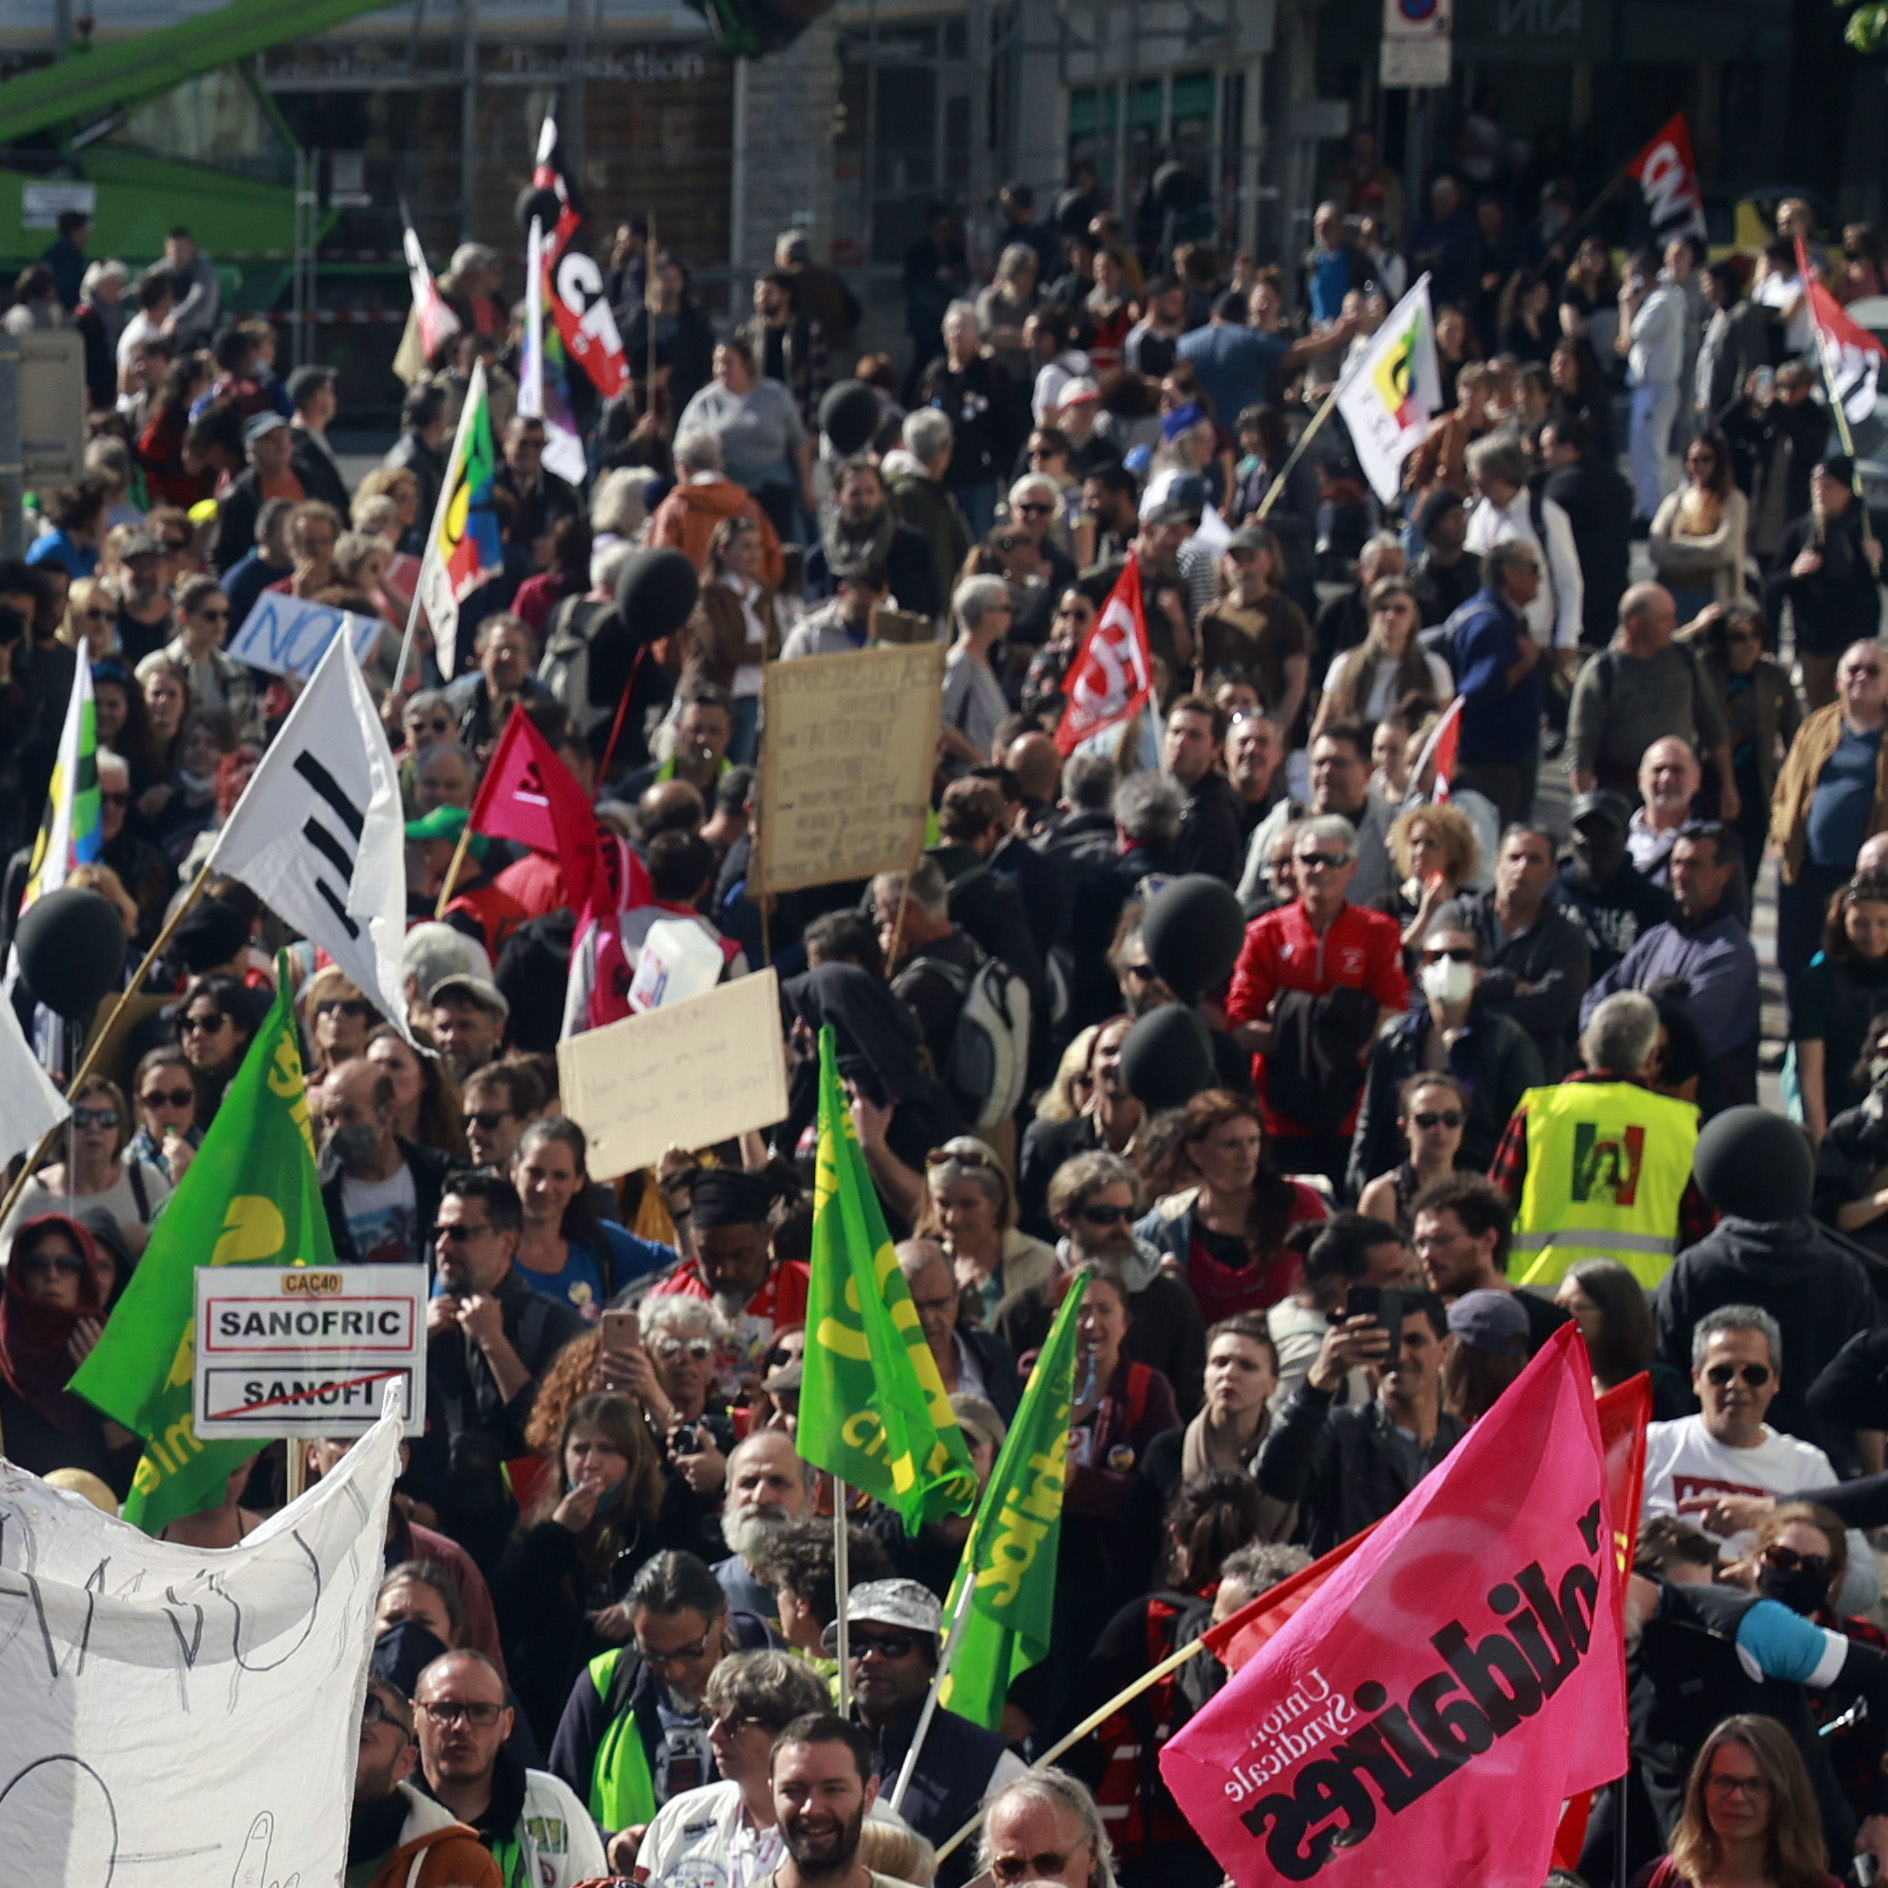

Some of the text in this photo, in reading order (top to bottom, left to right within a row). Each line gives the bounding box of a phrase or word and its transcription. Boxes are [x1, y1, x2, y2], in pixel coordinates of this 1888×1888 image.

[285, 1274, 340, 1294] CAC40
[218, 1308, 402, 1339] SANOFRIC
[241, 1377, 376, 1409] SANOFI
